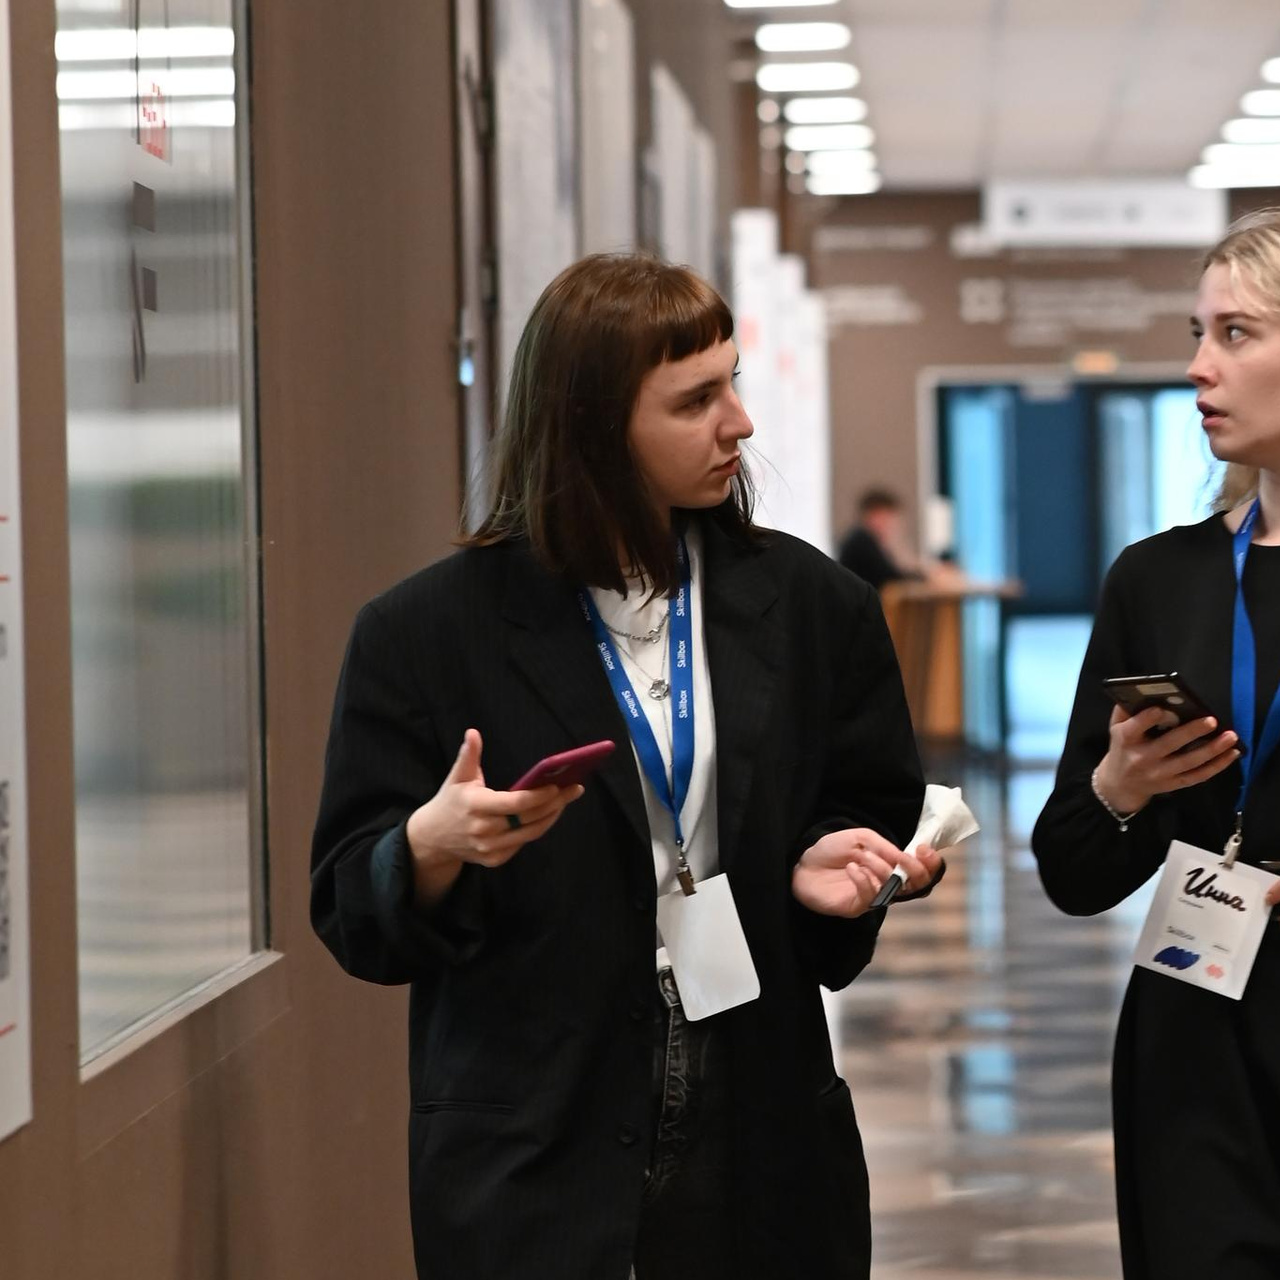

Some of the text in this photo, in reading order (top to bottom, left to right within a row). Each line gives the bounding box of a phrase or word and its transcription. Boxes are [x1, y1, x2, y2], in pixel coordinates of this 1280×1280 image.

[676, 587, 685, 617] Skillbox
[597, 642, 615, 671] Skillbox
[677, 639, 686, 668] Skillbox
[621, 690, 639, 719] Skillbox
[678, 690, 688, 719] Skillbox
